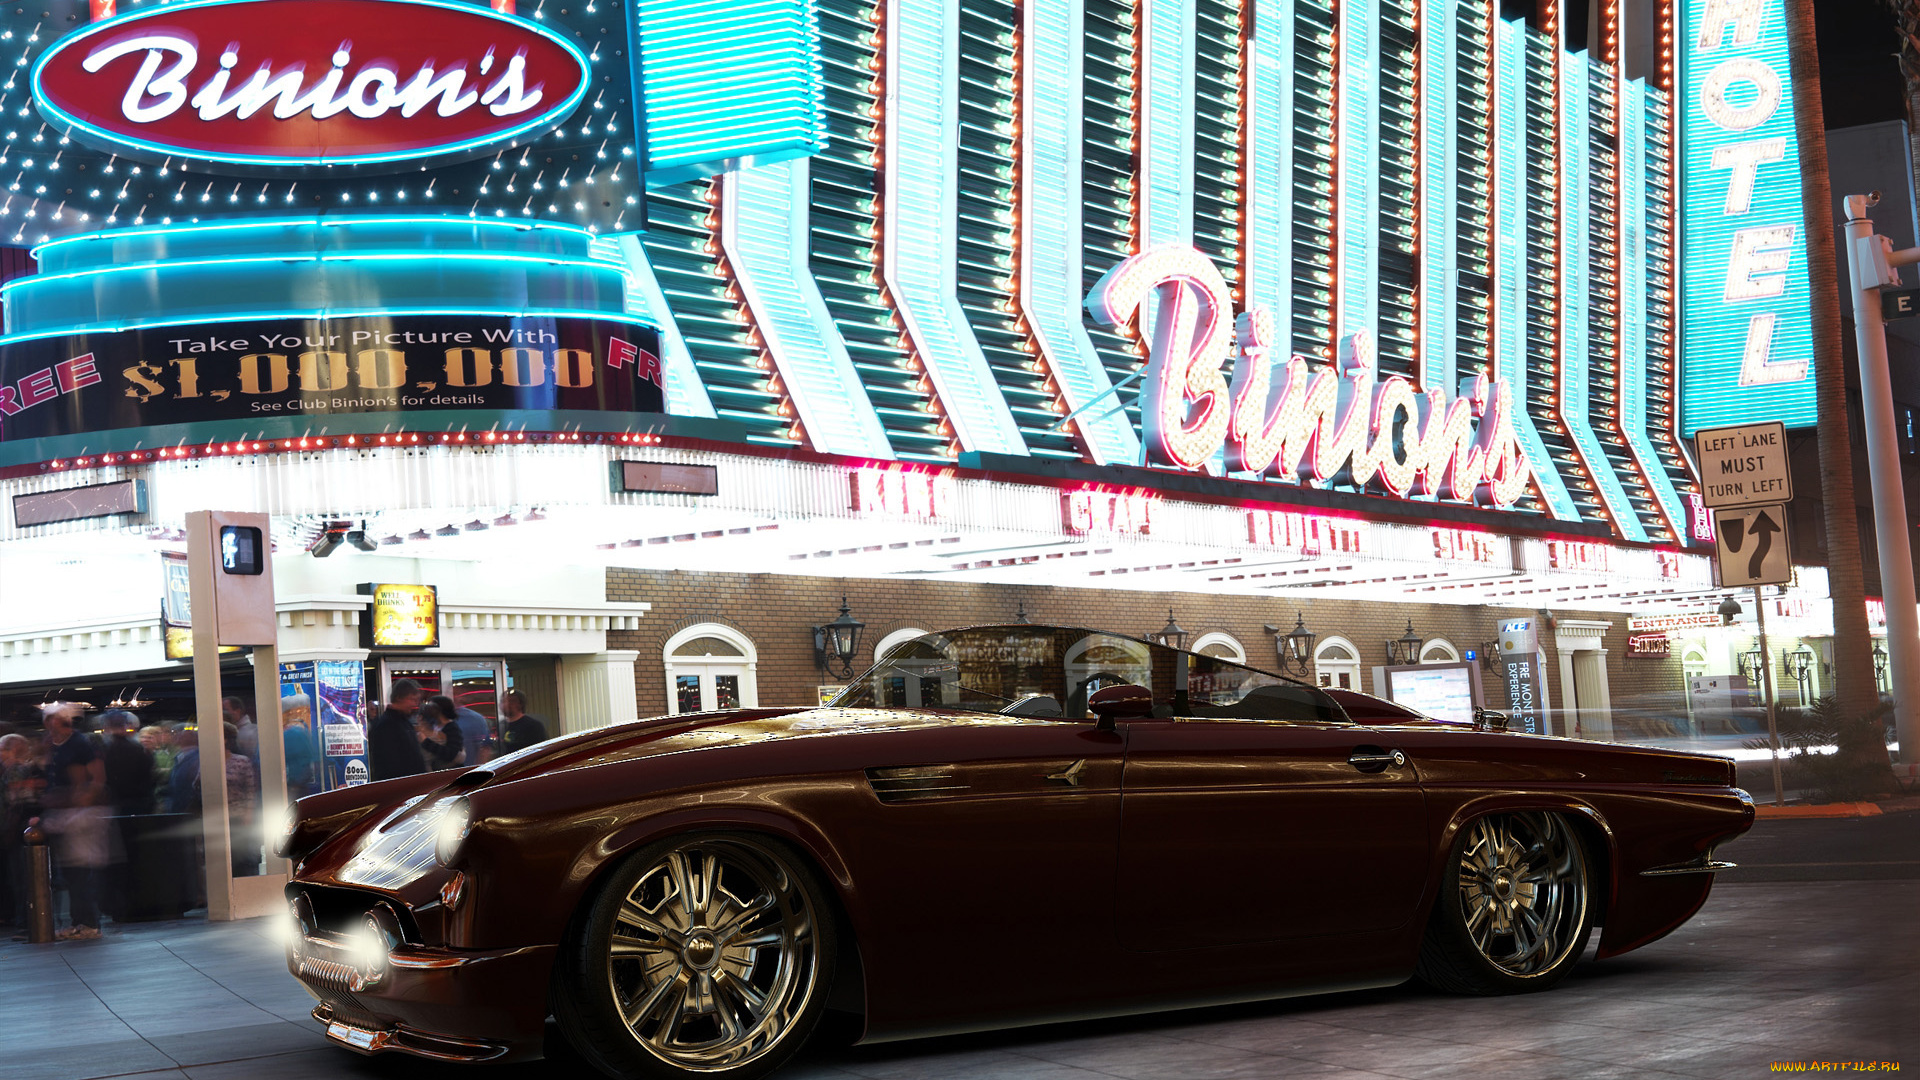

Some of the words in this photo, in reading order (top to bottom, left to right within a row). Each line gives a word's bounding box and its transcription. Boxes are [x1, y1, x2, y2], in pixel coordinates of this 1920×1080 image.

[82, 35, 544, 123] Binion's
[1897, 296, 1913, 312] E
[169, 336, 249, 353] Take
[260, 334, 340, 348] Your
[352, 330, 473, 345] Picture
[482, 328, 556, 344] With
[122, 347, 594, 403] $1,000,000
[1090, 243, 1530, 508] Binion's
[250, 402, 282, 412] See
[287, 400, 327, 410] Club
[332, 395, 397, 408] Binion's
[402, 395, 427, 405] for
[430, 394, 485, 405] details
[1705, 437, 1735, 452] LEFT
[1743, 433, 1777, 448] LANE
[1721, 456, 1765, 474] MUST
[1708, 482, 1743, 497] TURN
[1752, 479, 1783, 493] LEFT
[1633, 615, 1720, 629] ENTRANCE
[1508, 662, 1522, 719] EXPERIENCE
